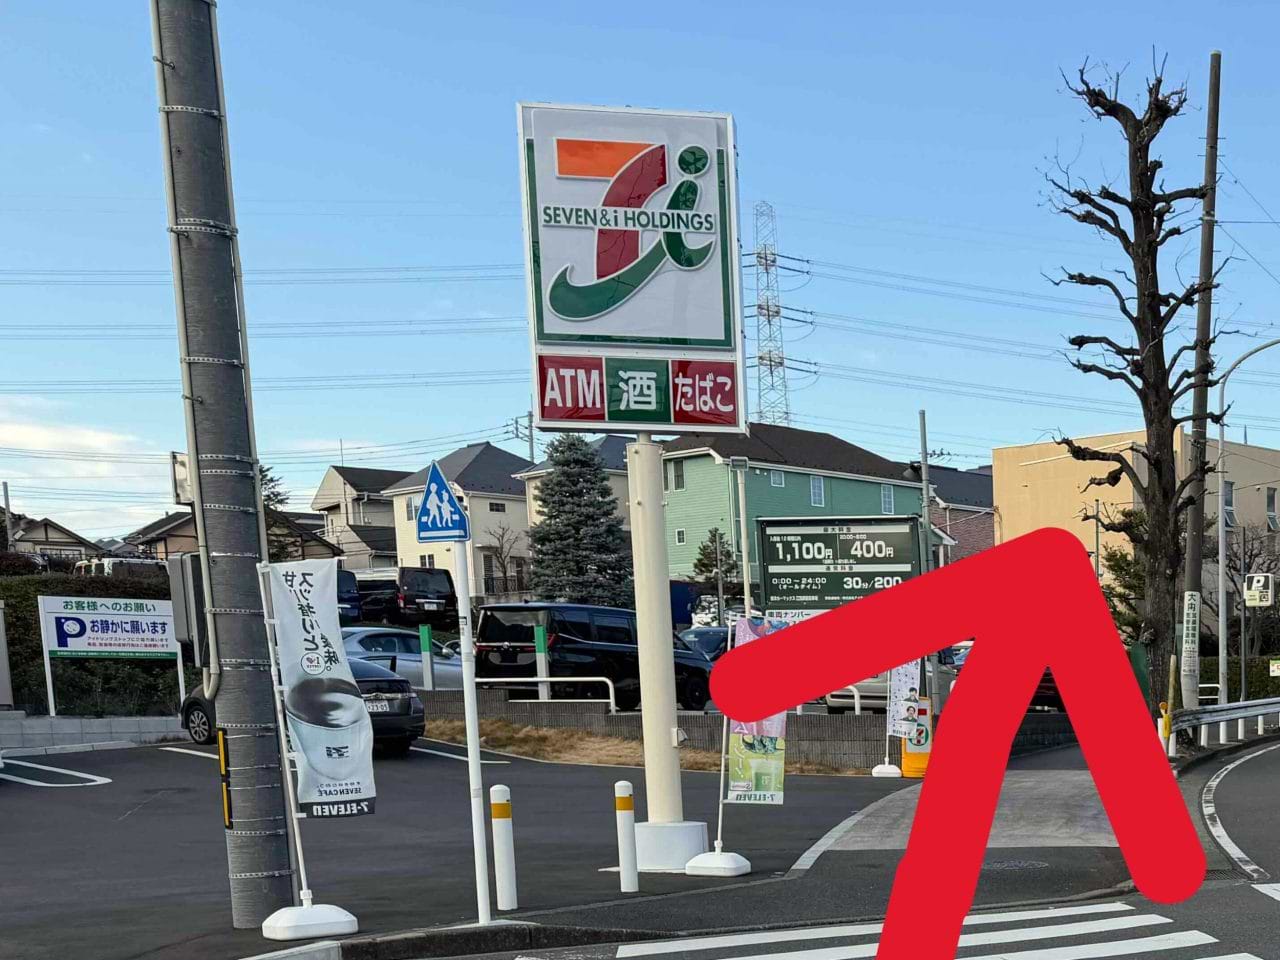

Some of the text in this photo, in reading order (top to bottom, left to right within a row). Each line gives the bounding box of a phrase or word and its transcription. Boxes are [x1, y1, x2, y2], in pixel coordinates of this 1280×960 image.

[624, 209, 714, 232] HOLDINGS
[544, 368, 601, 409] ATM
[619, 370, 657, 410] 酒
[674, 372, 734, 412] たばこ
[776, 542, 833, 561] 1,100円
[851, 540, 894, 558] 400円
[1251, 576, 1265, 590] P
[63, 601, 156, 612] お客様へのお願い
[90, 620, 168, 634] お静かに願います
